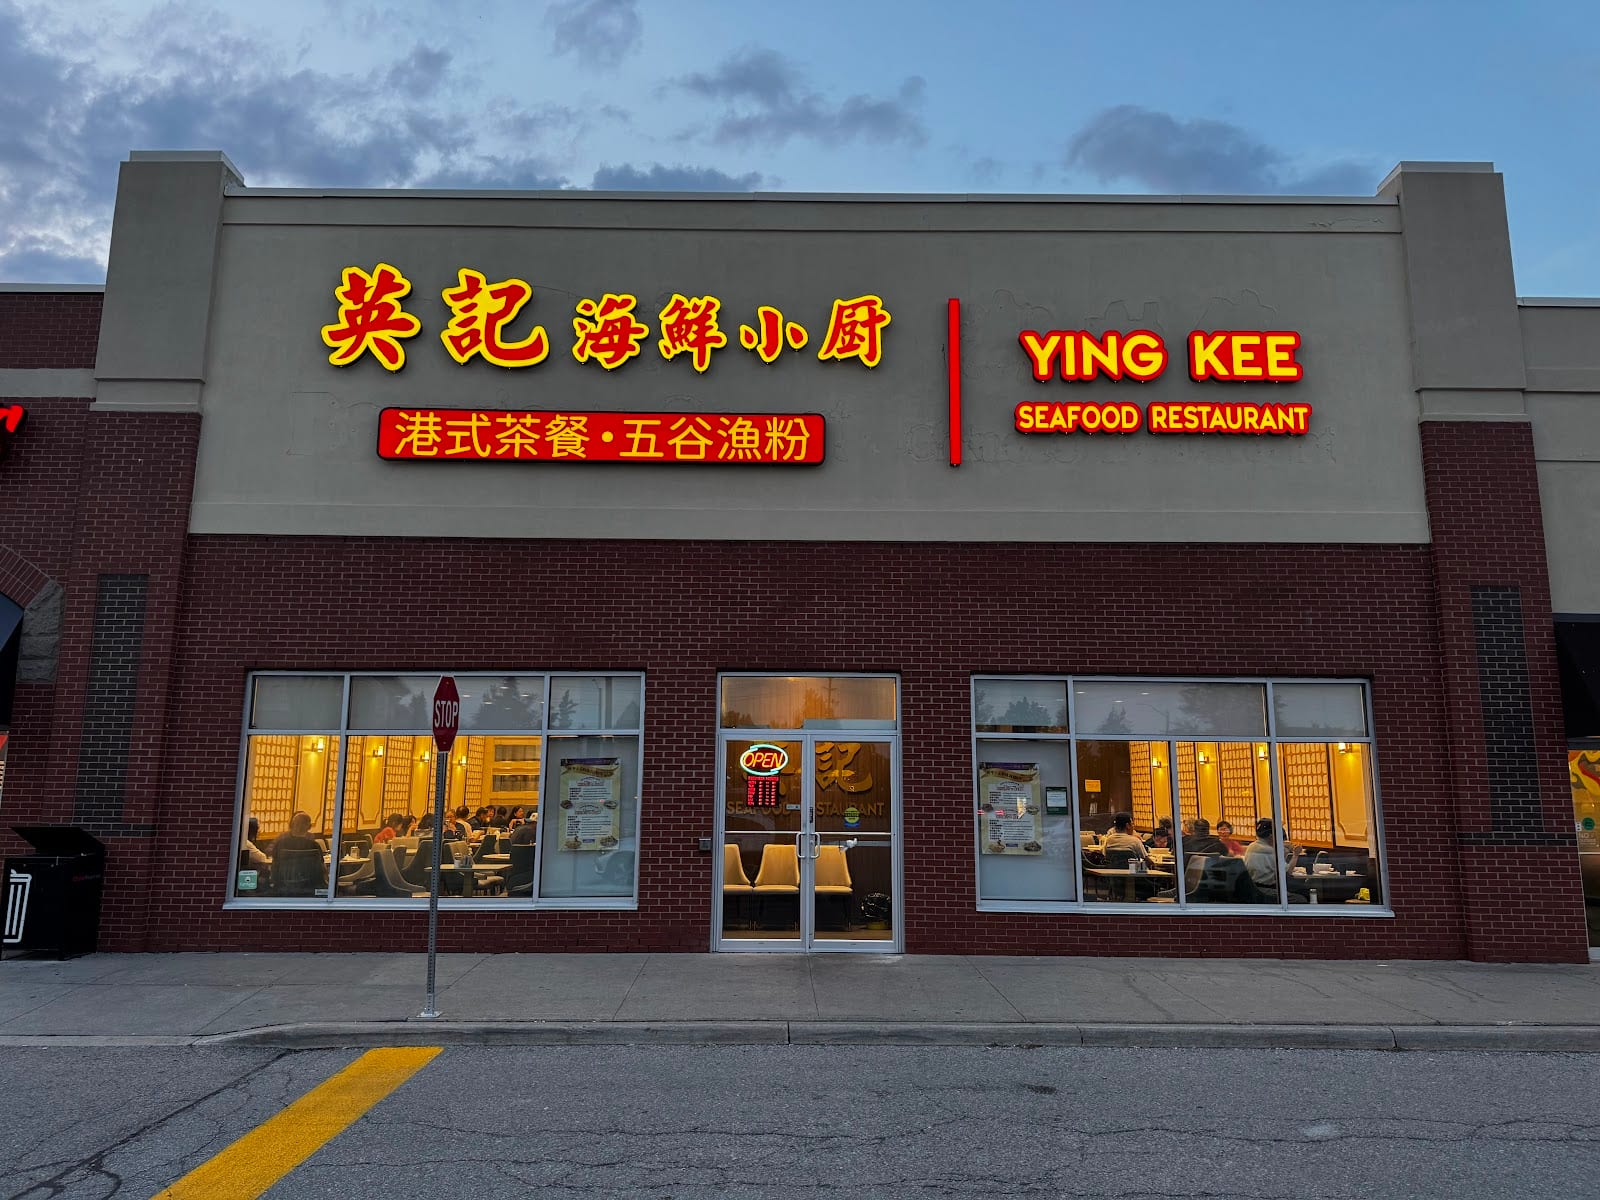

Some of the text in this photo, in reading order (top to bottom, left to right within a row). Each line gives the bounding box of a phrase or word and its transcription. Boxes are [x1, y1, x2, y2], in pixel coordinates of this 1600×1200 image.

[1021, 332, 1300, 379] YING KEE
[1018, 404, 1309, 431] SEAFOOD RESTAURANT
[434, 700, 459, 728] STOP
[743, 752, 783, 768] OPEN
